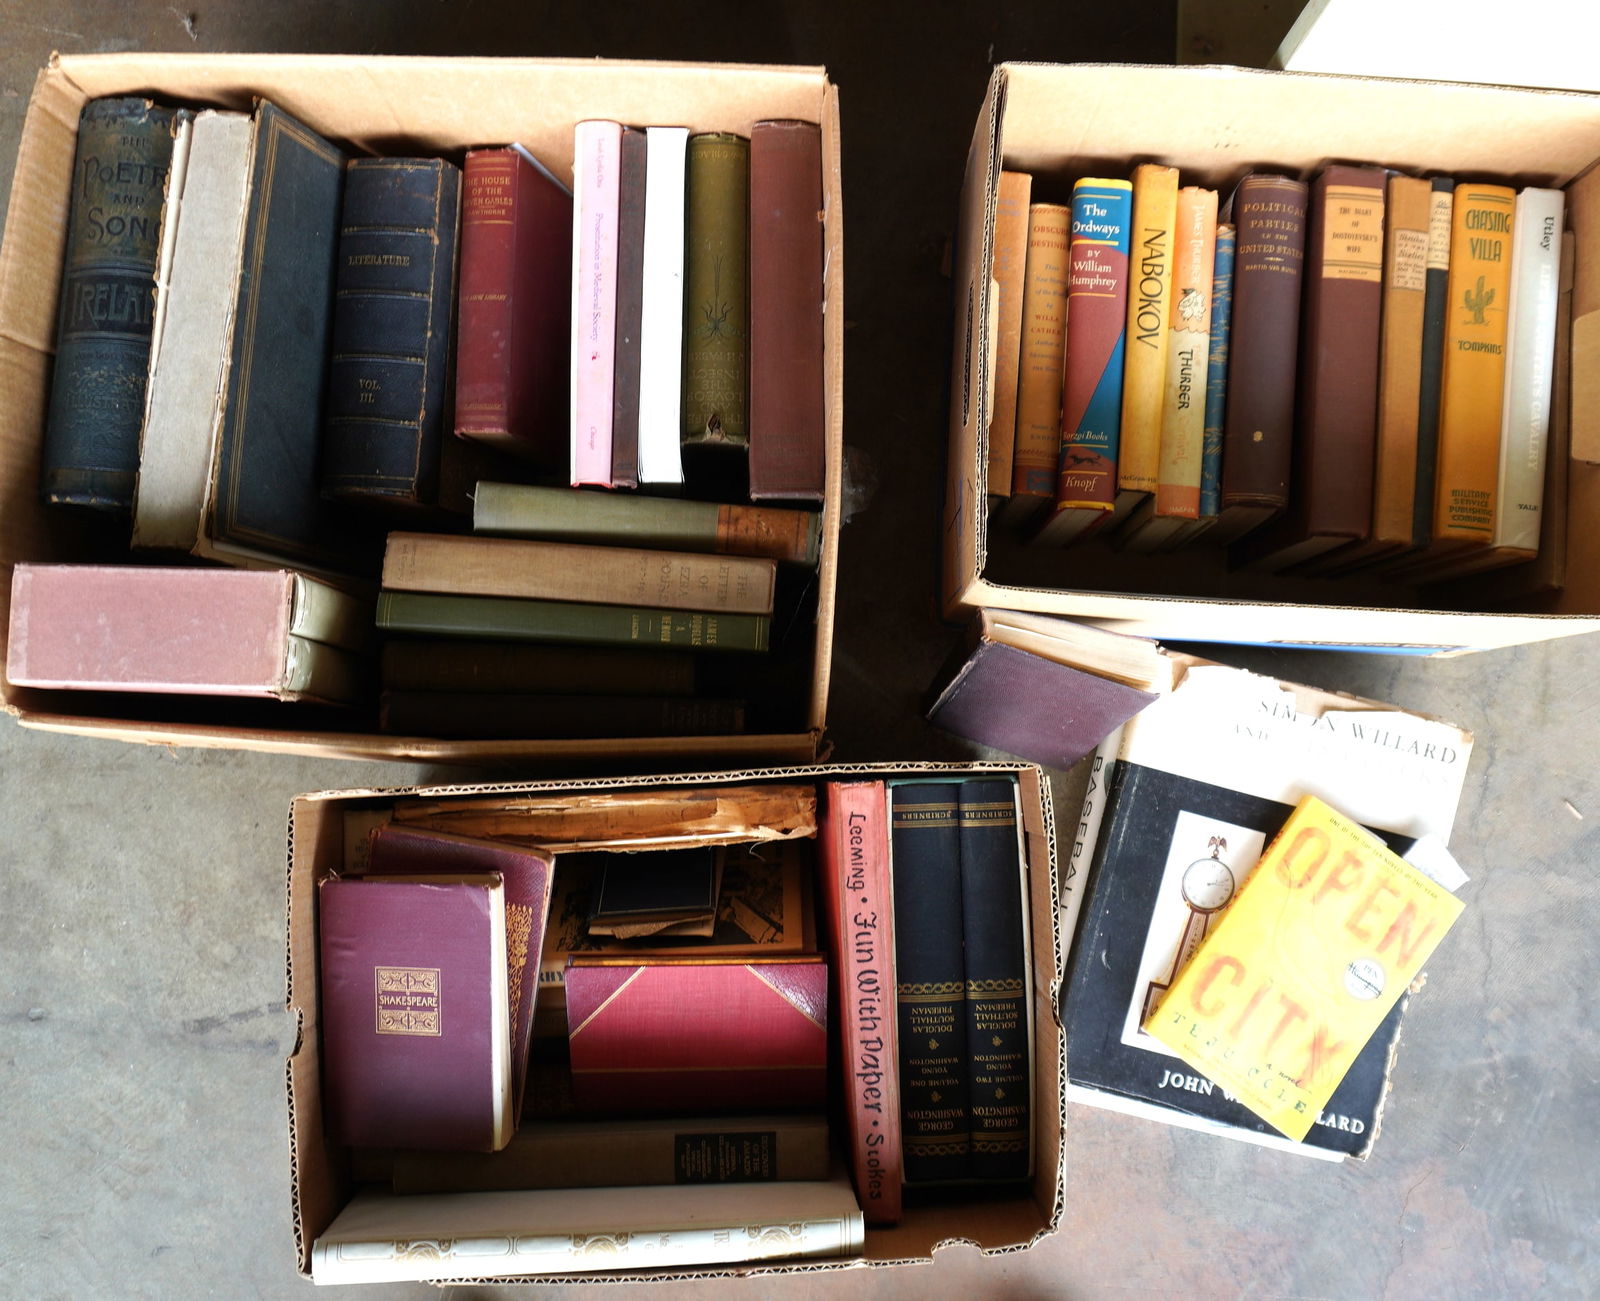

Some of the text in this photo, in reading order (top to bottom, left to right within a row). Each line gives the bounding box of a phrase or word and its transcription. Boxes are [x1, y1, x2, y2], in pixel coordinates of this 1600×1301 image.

[481, 176, 511, 186] HOUSE
[472, 187, 502, 196] OF THE
[113, 193, 144, 205] AND
[485, 197, 513, 207] GABLES
[1083, 203, 1107, 217] The
[1243, 202, 1305, 218] POLITICAL
[1339, 206, 1351, 216] THE
[88, 207, 161, 241] SON
[1250, 219, 1300, 233] PARTIES
[1466, 208, 1511, 234] CHASING
[1072, 220, 1120, 239] Ordways
[1540, 216, 1555, 252] Utley
[1275, 233, 1288, 241] THE
[1088, 250, 1101, 258] BY
[1240, 244, 1275, 255] UNITED
[1346, 245, 1361, 254] WIFE
[1470, 237, 1502, 263] VILLA
[347, 254, 410, 267] LITERATURE
[1074, 260, 1112, 273] William
[1269, 264, 1280, 272] VAN
[592, 272, 603, 310] Medieval
[1136, 228, 1166, 350] NABOKOV
[1035, 314, 1059, 322] WILLA
[590, 312, 601, 343] Society
[1458, 340, 1503, 356] TOMPKINS
[691, 368, 740, 380] INSECT
[1178, 349, 1193, 410] THURBER
[702, 380, 727, 390] THE
[706, 392, 742, 402] LOVE
[1086, 430, 1108, 441] Books
[1528, 401, 1543, 472] CAVALRY
[1066, 476, 1097, 492] Knopf
[1451, 488, 1492, 500] MILITARY
[1453, 498, 1489, 508] SERVICE
[1517, 503, 1539, 512] YALE
[1449, 505, 1493, 517] PUBLISHING
[679, 566, 690, 598] EZRA
[699, 575, 709, 592] OF
[737, 574, 749, 601] THE
[691, 614, 704, 648] DOUGLAS
[706, 615, 718, 645] JAMES
[1258, 699, 1336, 732] SIMN
[1352, 721, 1457, 765] WILLARD
[902, 810, 952, 821] SCRIBNERS
[965, 808, 1013, 819] SCRIBNERS
[1275, 825, 1437, 970] OPEN
[379, 995, 438, 1008] SHAKESPEARE
[846, 811, 886, 1201] Leeming Fun With Paper Stokes
[975, 1002, 1016, 1012] FREEMAN
[911, 1005, 953, 1015] FREEMAN
[974, 1011, 1018, 1021] SOUTHALL
[909, 1014, 955, 1024] SOUTHALL
[1188, 952, 1346, 1091] CITY
[912, 1024, 954, 1034] DOUGLAS
[976, 1020, 1017, 1031] DOUGLAS
[908, 1055, 960, 1065] WASHINGTON
[973, 1053, 1023, 1062] WASHINGTON
[920, 1065, 948, 1075] YOUNG
[986, 1062, 1013, 1072] YOUNG
[910, 1078, 960, 1088] VOLUME ONE
[975, 1075, 993, 1084] TWO
[1158, 1070, 1215, 1097] JOHN
[1278, 1070, 1304, 1089] novel
[907, 1107, 964, 1120] WASHINGTON
[972, 1106, 1026, 1118] WASHINGTON
[917, 1120, 954, 1132] GEORGE
[983, 1117, 1018, 1128] GEORGE
